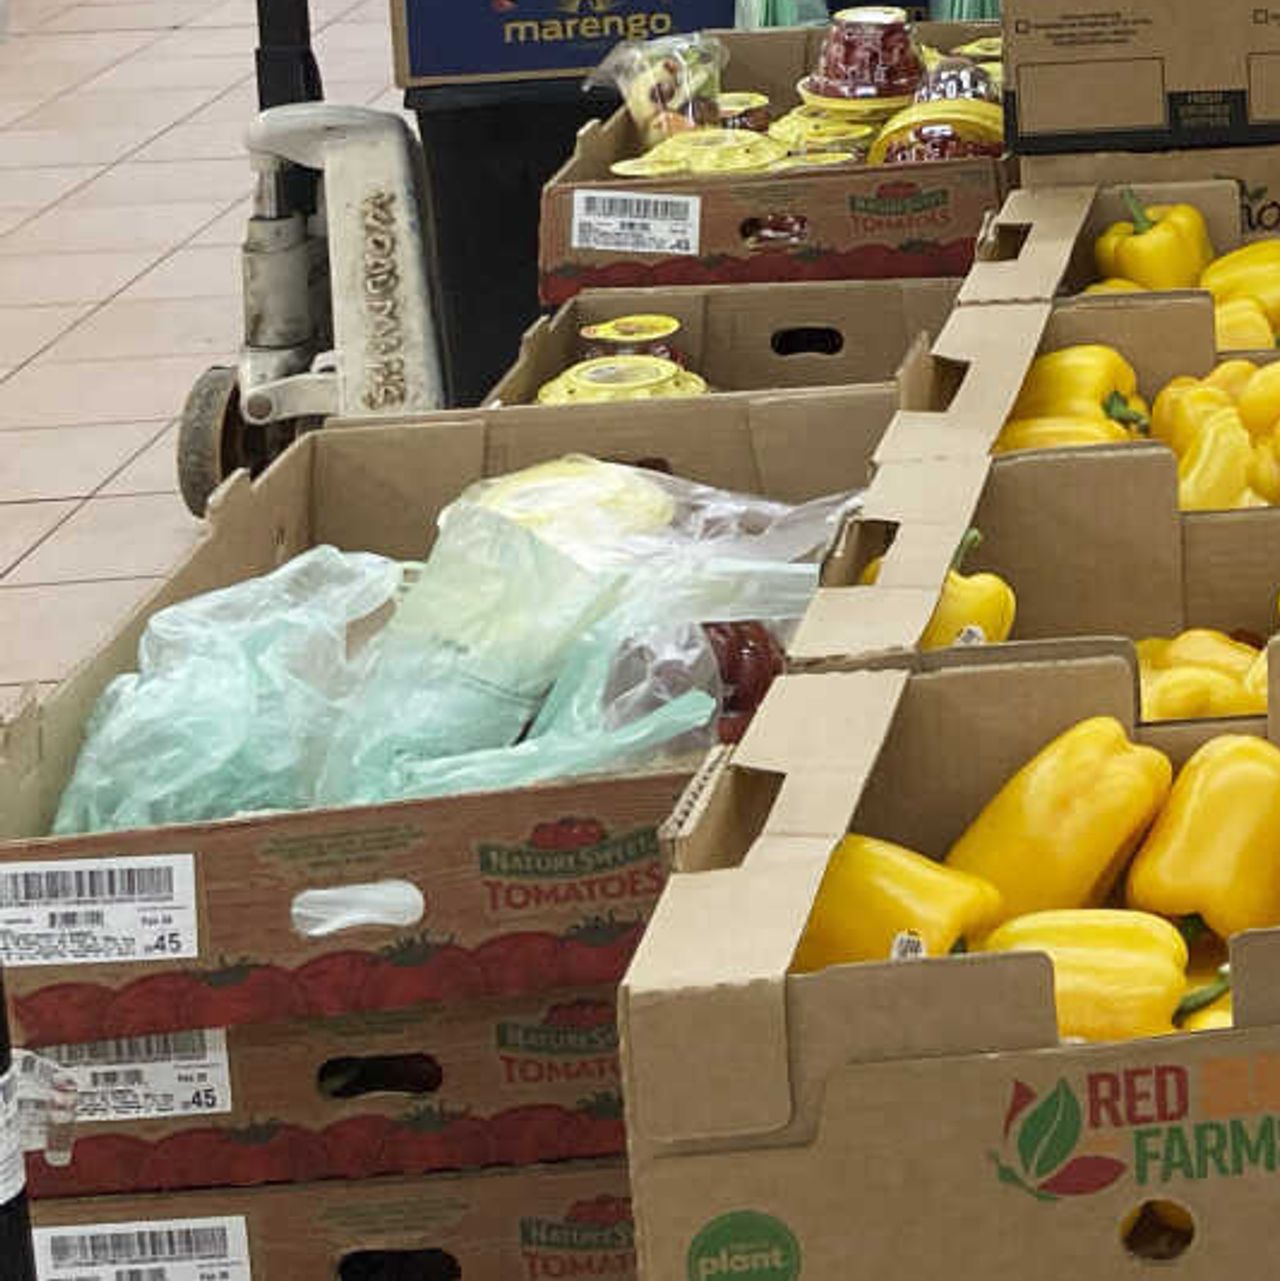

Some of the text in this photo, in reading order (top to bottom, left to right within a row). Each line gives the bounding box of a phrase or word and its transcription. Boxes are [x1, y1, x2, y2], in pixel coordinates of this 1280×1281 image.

[503, 12, 672, 43] marengo
[482, 861, 663, 911] TOMATOES
[153, 932, 182, 953] 45
[191, 1087, 217, 1108] 45
[1086, 1064, 1189, 1129] RED
[700, 1249, 790, 1278] plant
